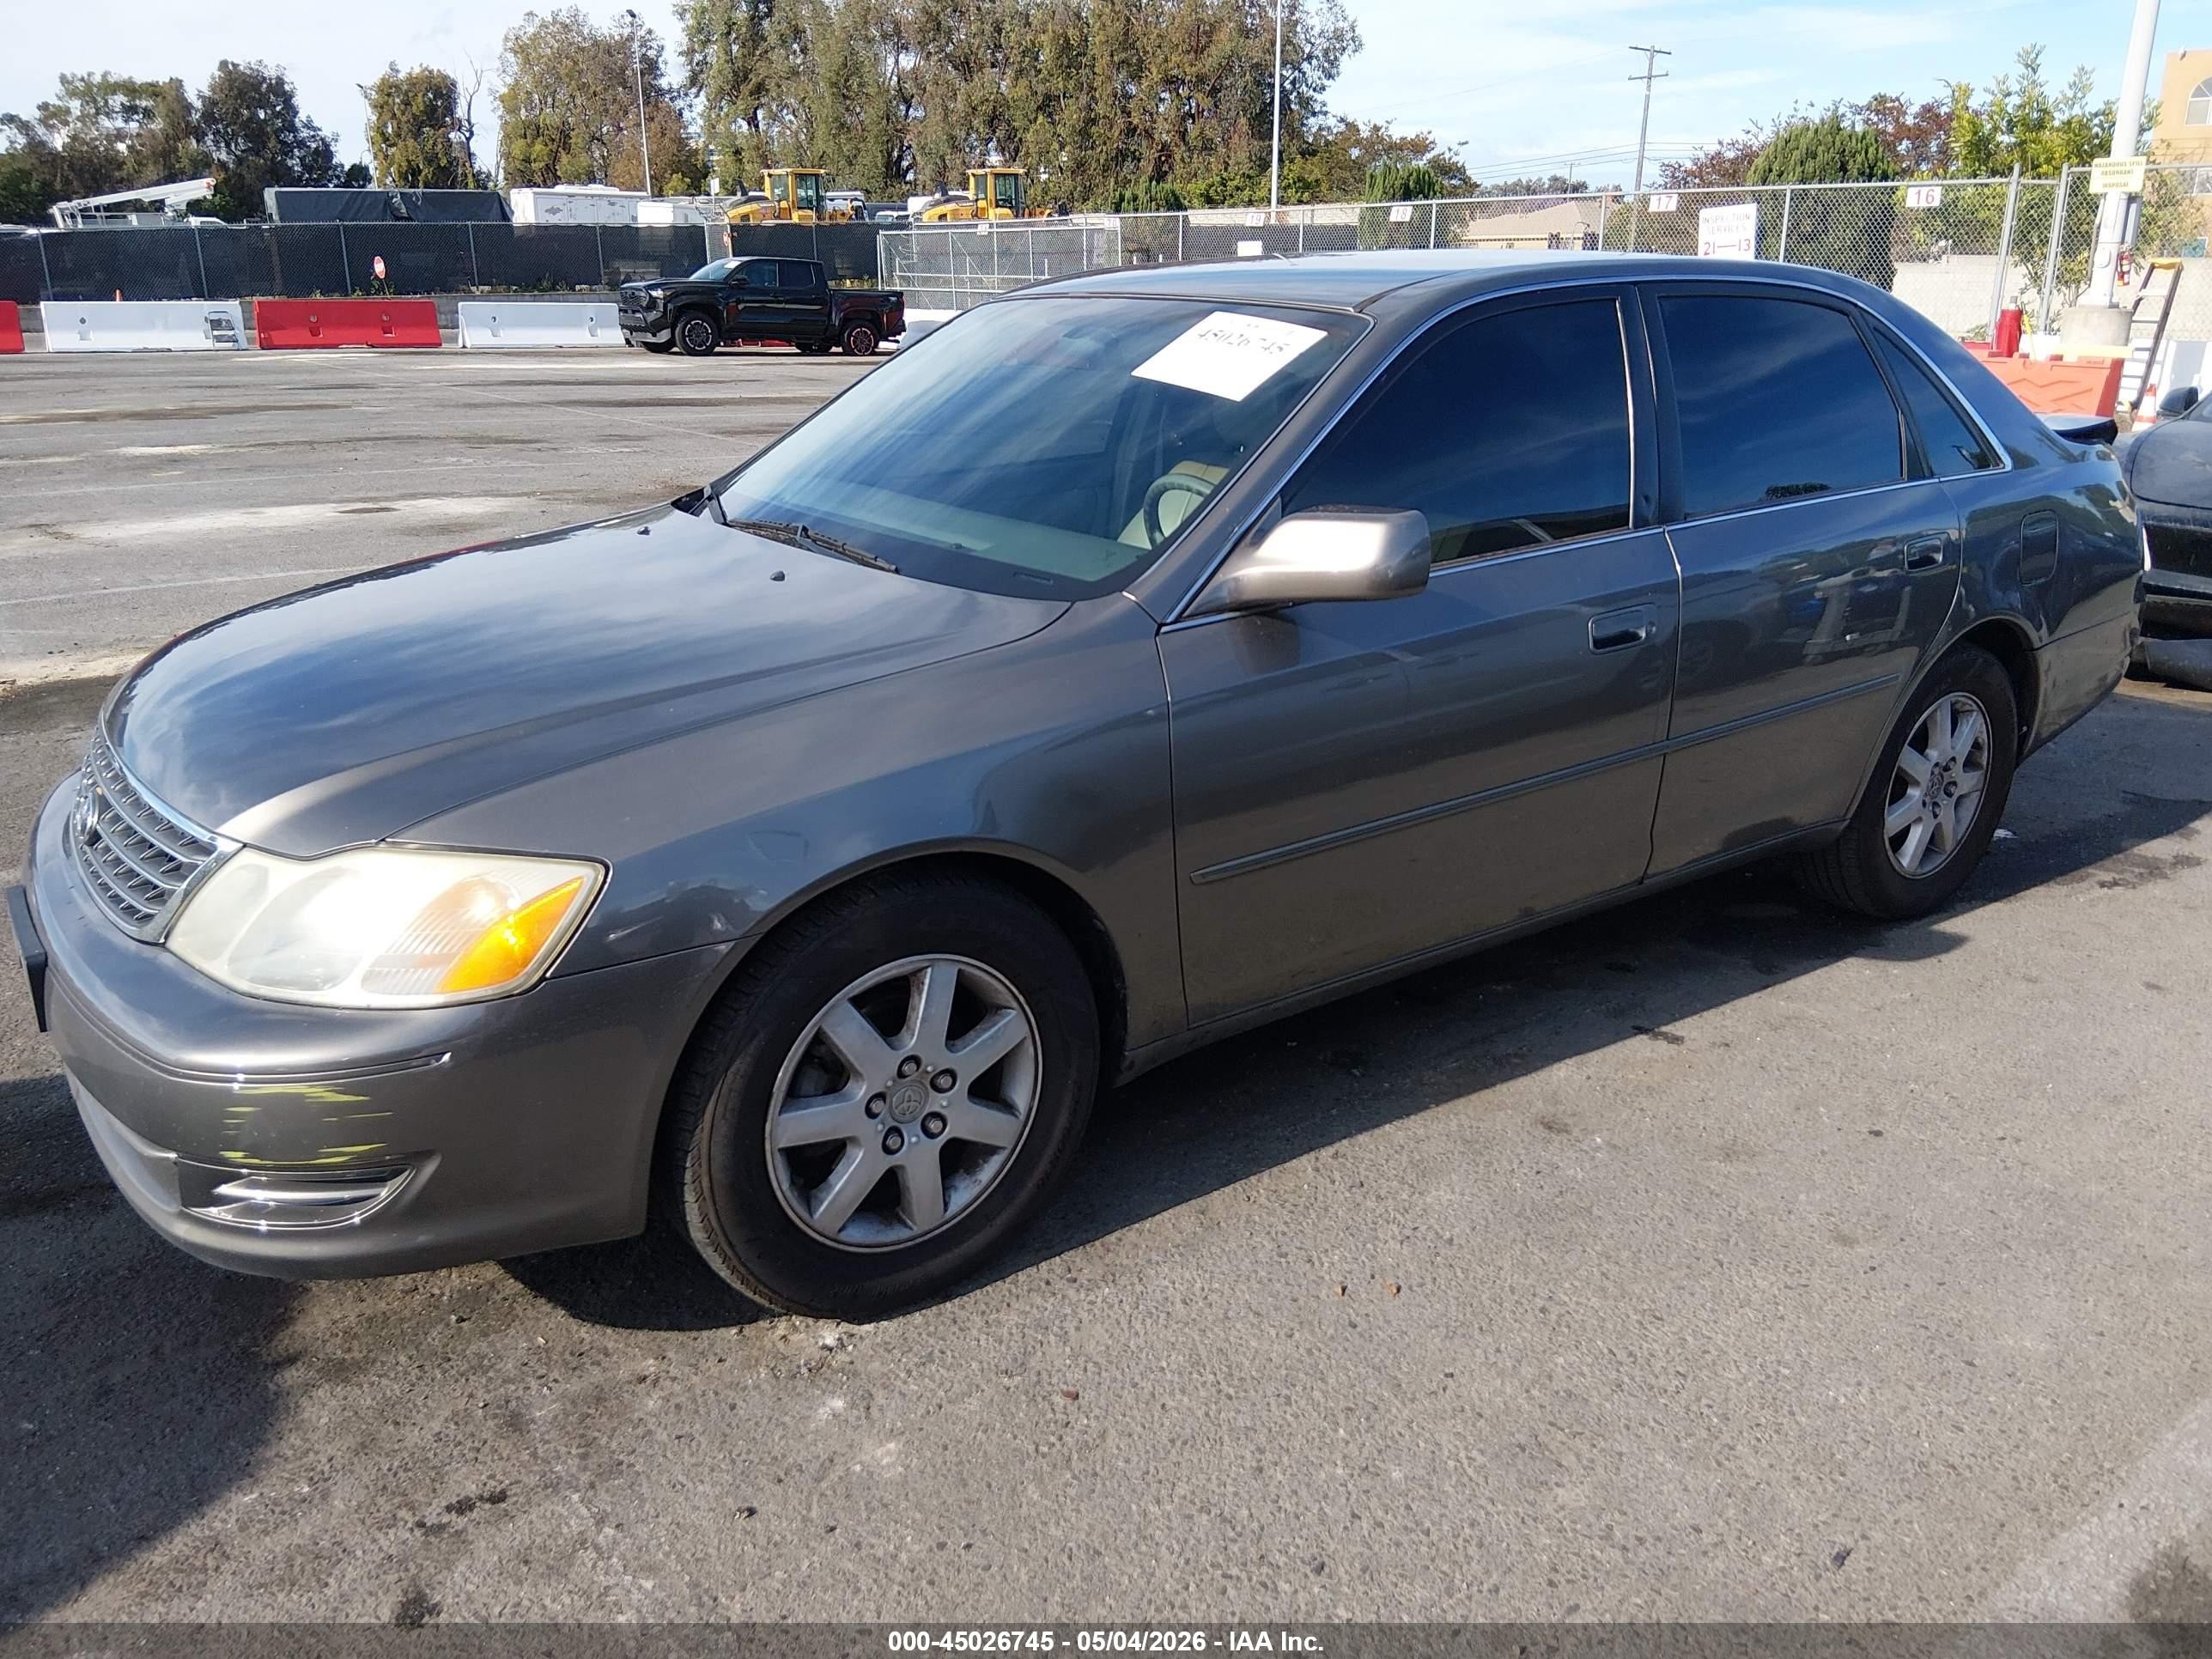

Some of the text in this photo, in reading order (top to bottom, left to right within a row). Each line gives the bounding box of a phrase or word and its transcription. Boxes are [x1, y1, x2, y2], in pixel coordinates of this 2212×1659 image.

[1915, 188, 1935, 204] 16
[1656, 195, 1674, 210] 17
[1250, 214, 1261, 225] 19
[1395, 208, 1407, 220] 18
[1701, 212, 1751, 224] INSPETION
